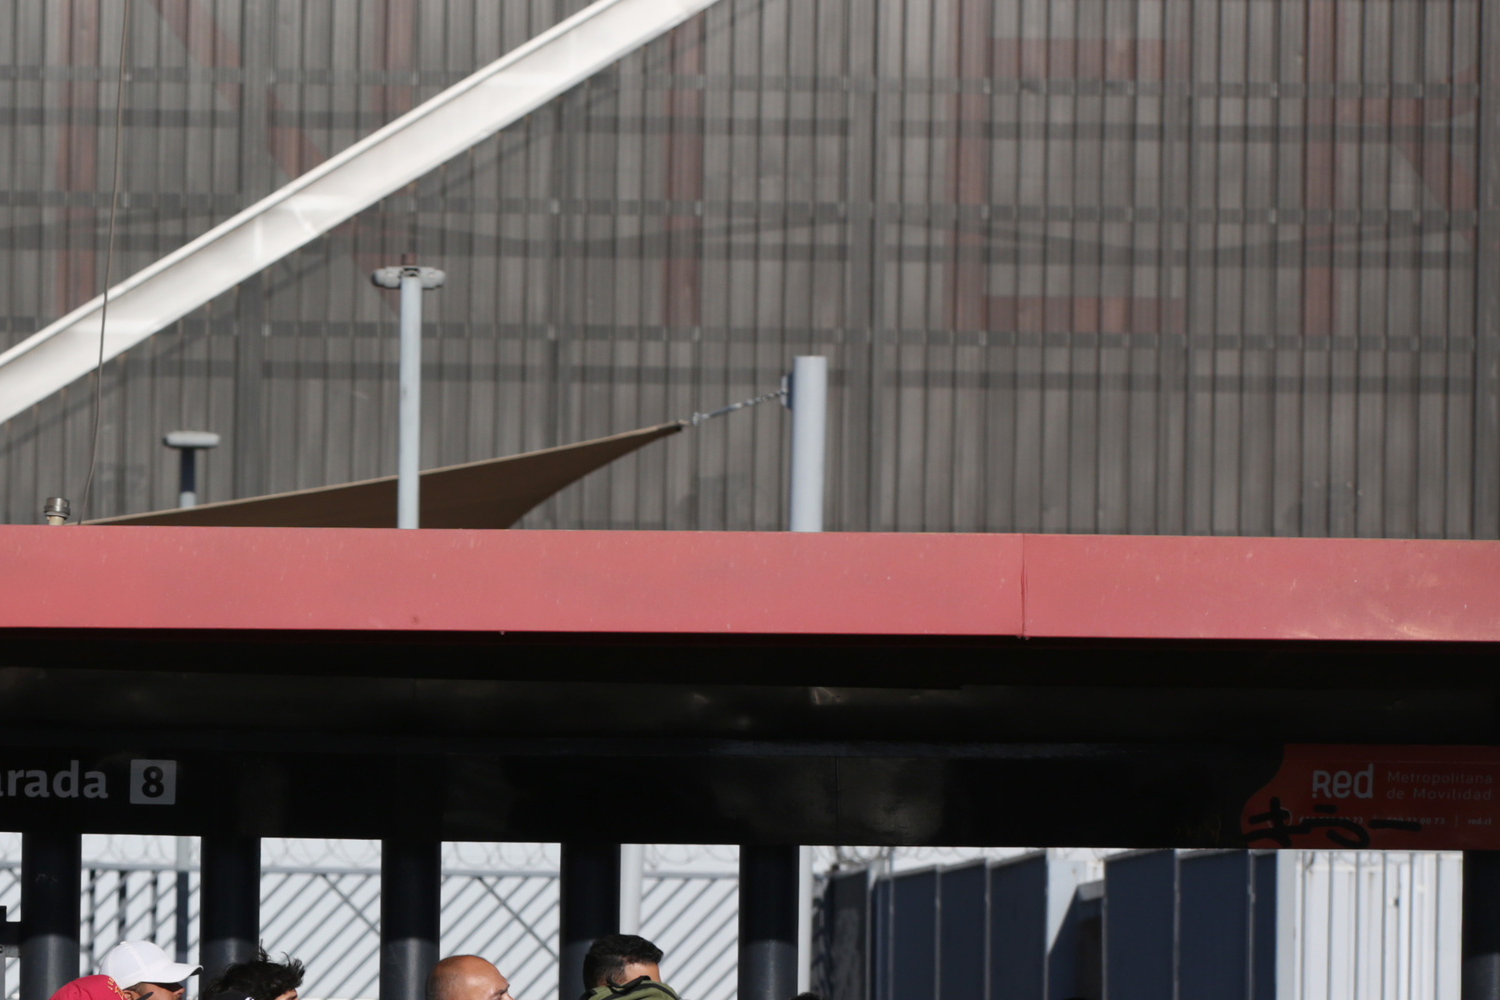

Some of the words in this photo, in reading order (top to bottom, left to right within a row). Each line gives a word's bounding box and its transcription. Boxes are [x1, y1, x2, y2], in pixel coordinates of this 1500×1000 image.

[140, 765, 165, 799] 8
[1311, 762, 1374, 800] Red
[1386, 770, 1494, 787] Metropolitana
[1386, 787, 1406, 801] de
[1412, 787, 1493, 801] Movilidad
